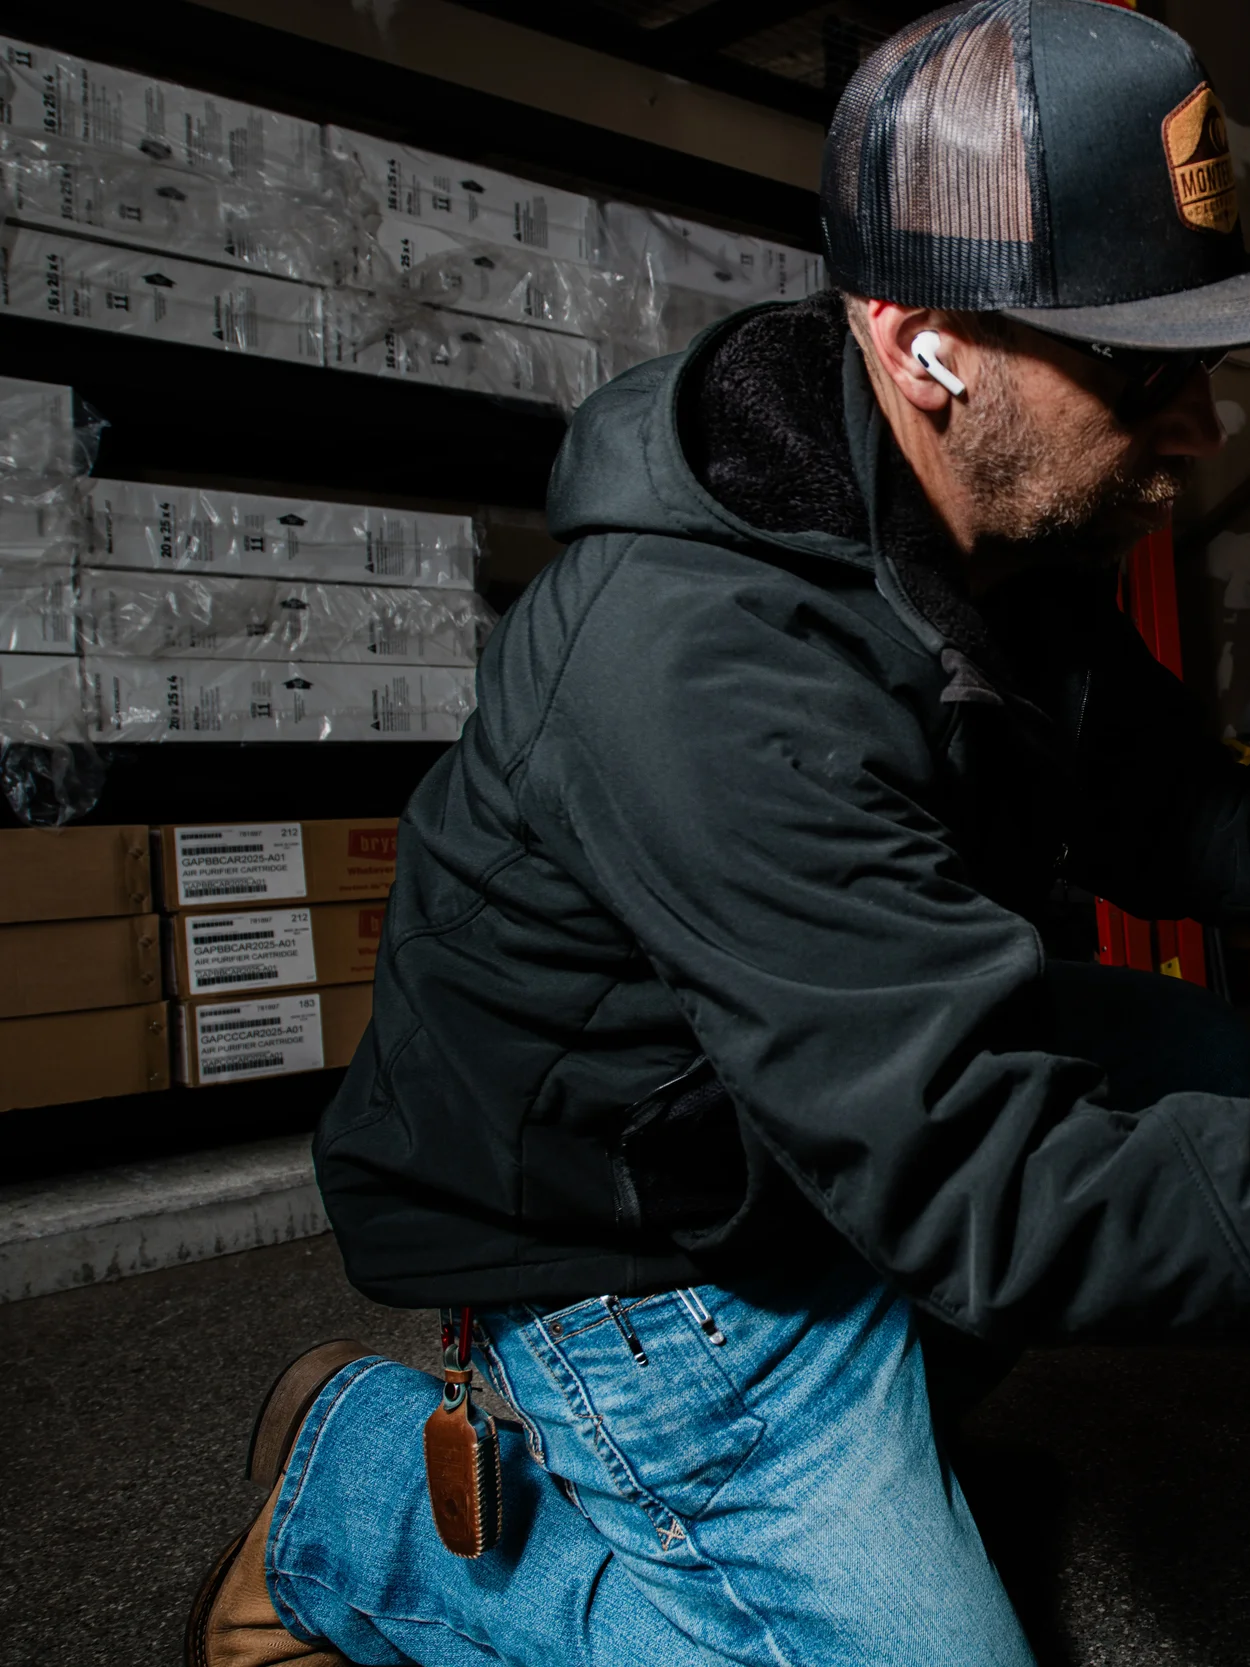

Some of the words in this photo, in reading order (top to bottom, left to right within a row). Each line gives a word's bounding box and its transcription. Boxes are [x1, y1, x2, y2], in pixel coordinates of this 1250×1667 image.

[44, 94, 55, 108] 25
[44, 119, 56, 134] 16
[48, 298, 60, 313] 16
[114, 295, 129, 311] 11
[160, 520, 171, 533] 25
[160, 544, 172, 558] 20
[251, 537, 264, 552] 11
[168, 693, 178, 706] 25
[258, 704, 271, 718] 11
[169, 718, 180, 730] 20
[281, 828, 298, 837] 212
[182, 854, 285, 867] GAPBBCAR2025-A01
[200, 866, 238, 875] PURIFIER
[240, 864, 288, 874] CARTRIDGE
[292, 913, 308, 922] 212
[194, 939, 296, 956] GAPBBCAR2025-A01
[212, 955, 249, 964] PURIFIER
[252, 950, 298, 960] CARTRIDGE
[299, 999, 315, 1008] 183
[201, 1025, 302, 1044] GAPCCCAR2025-A01
[218, 1042, 256, 1052] PURIFIER
[258, 1036, 304, 1047] CARTRIDGE
